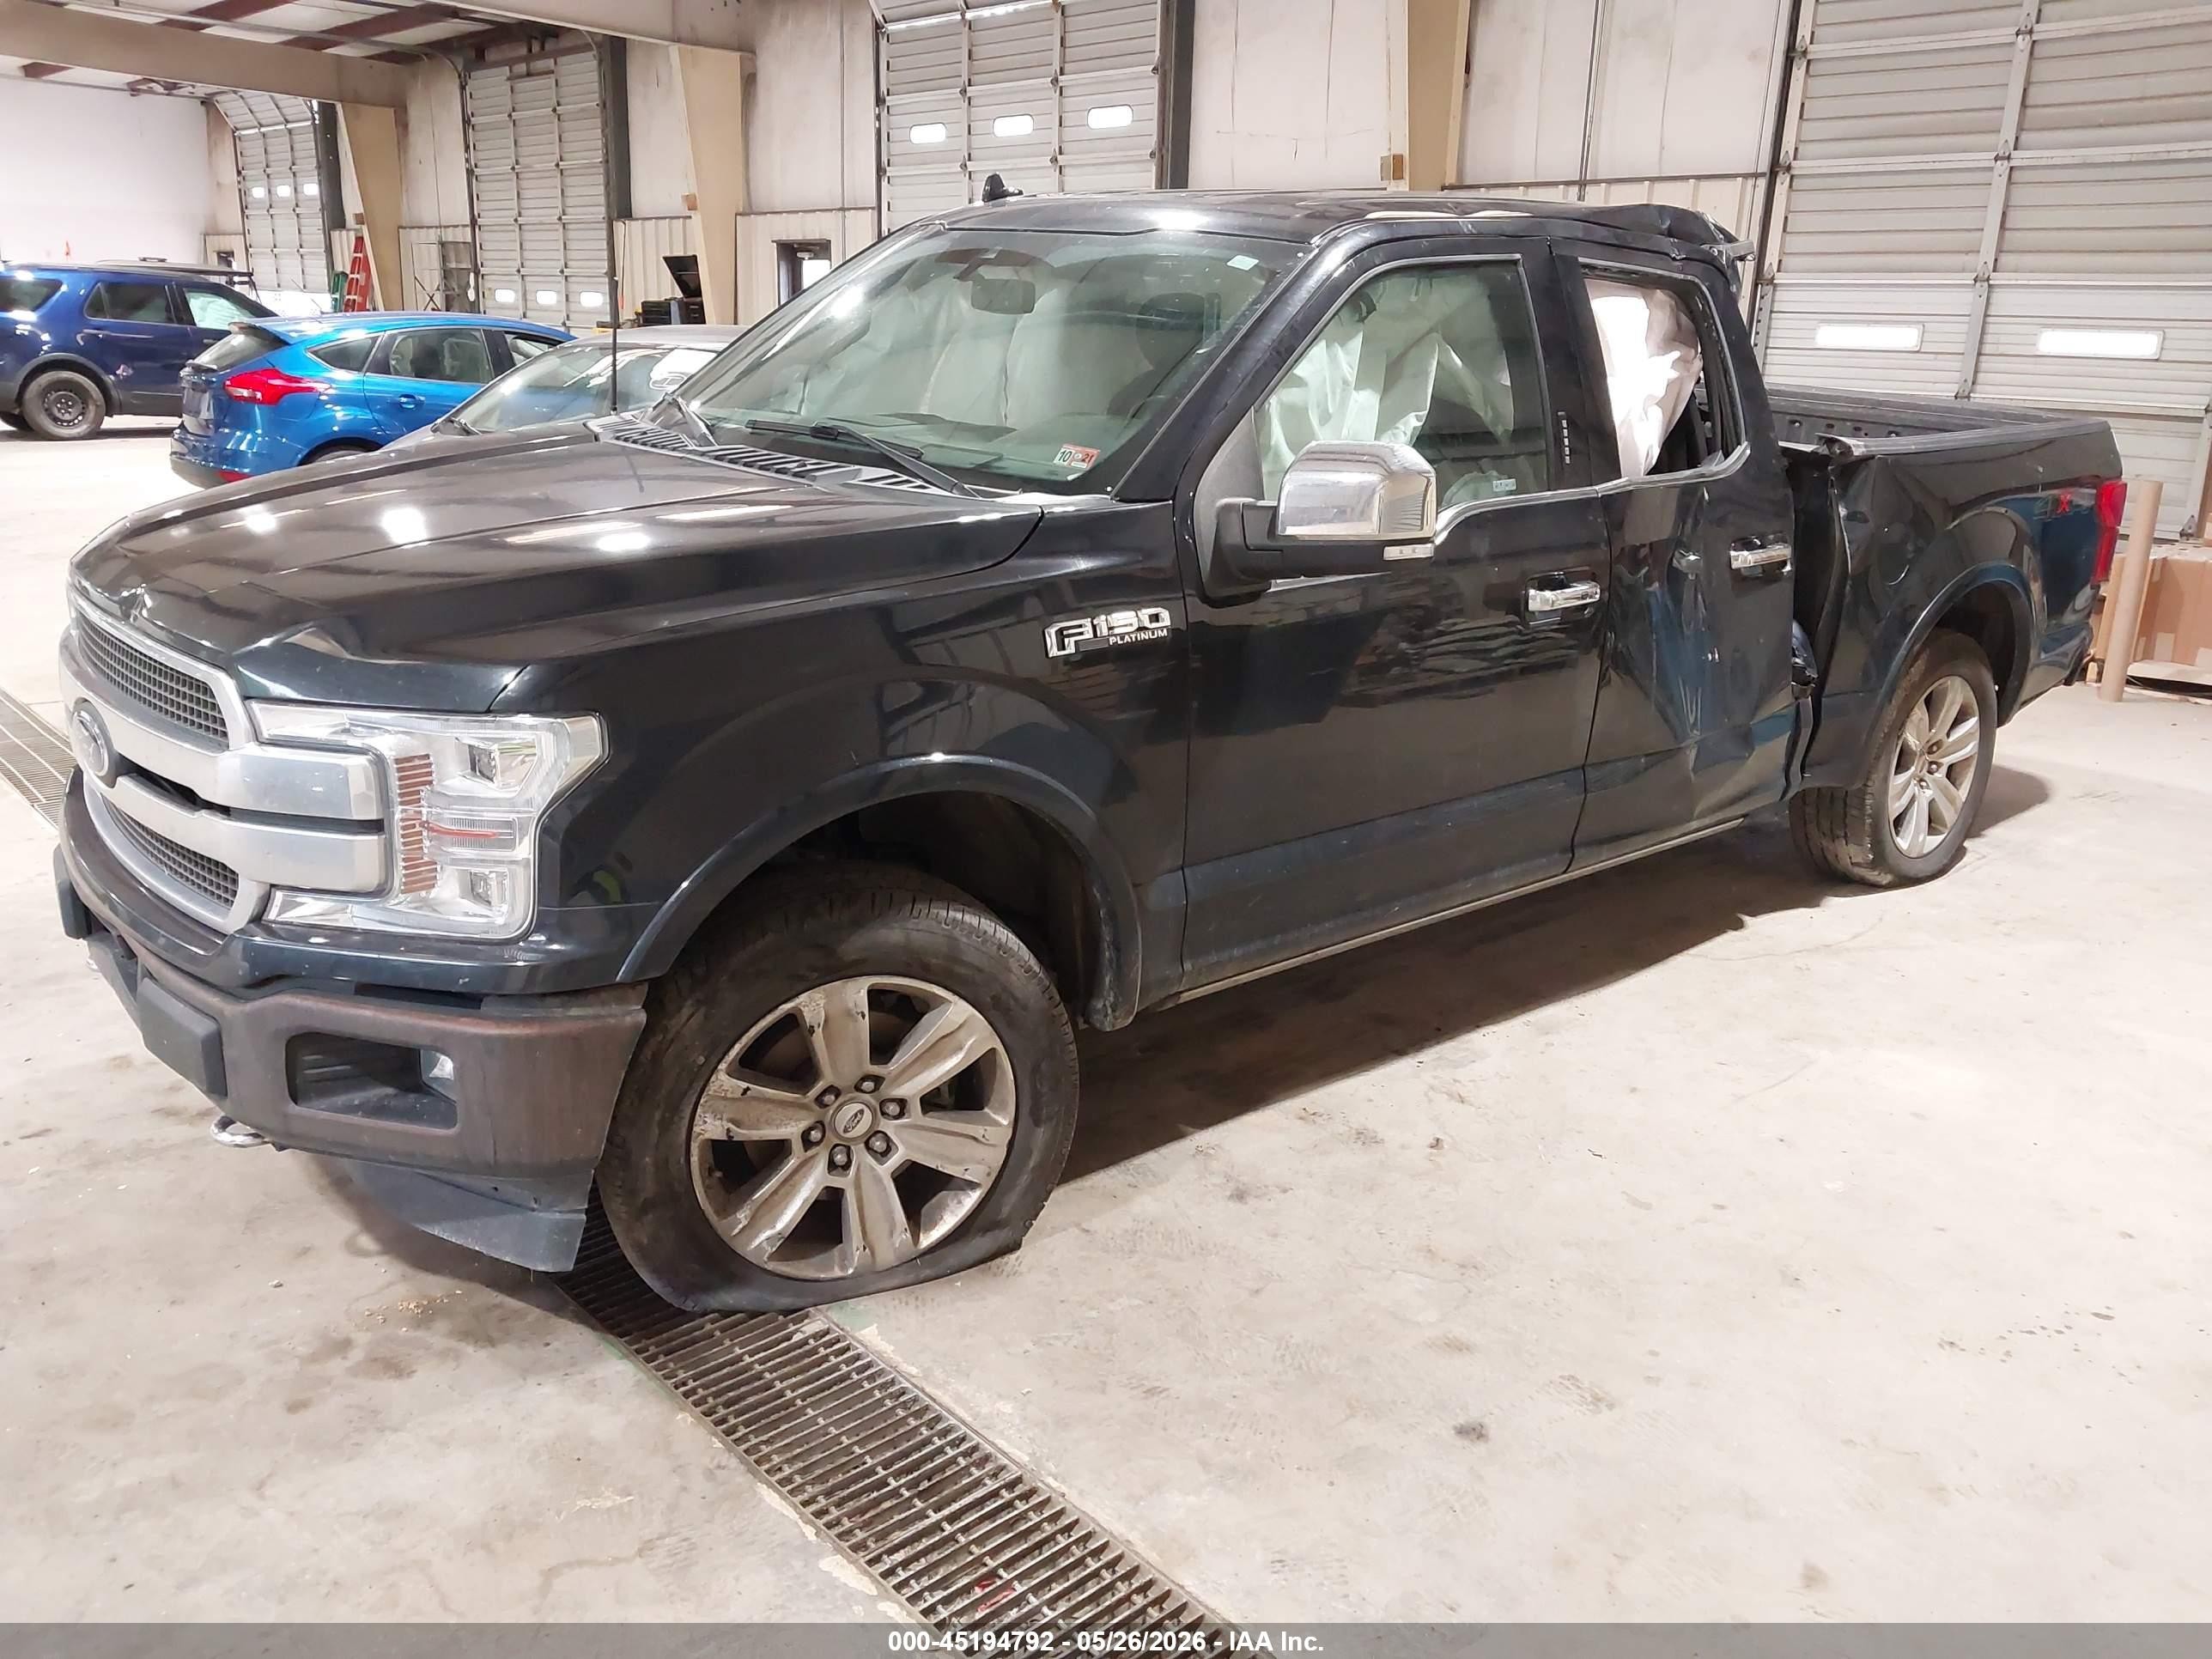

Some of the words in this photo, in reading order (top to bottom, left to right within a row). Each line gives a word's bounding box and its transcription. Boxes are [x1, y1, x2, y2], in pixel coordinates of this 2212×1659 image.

[1058, 450, 1073, 462] 10
[1082, 453, 1095, 464] 21
[1109, 628, 1168, 646] PLATINUM
